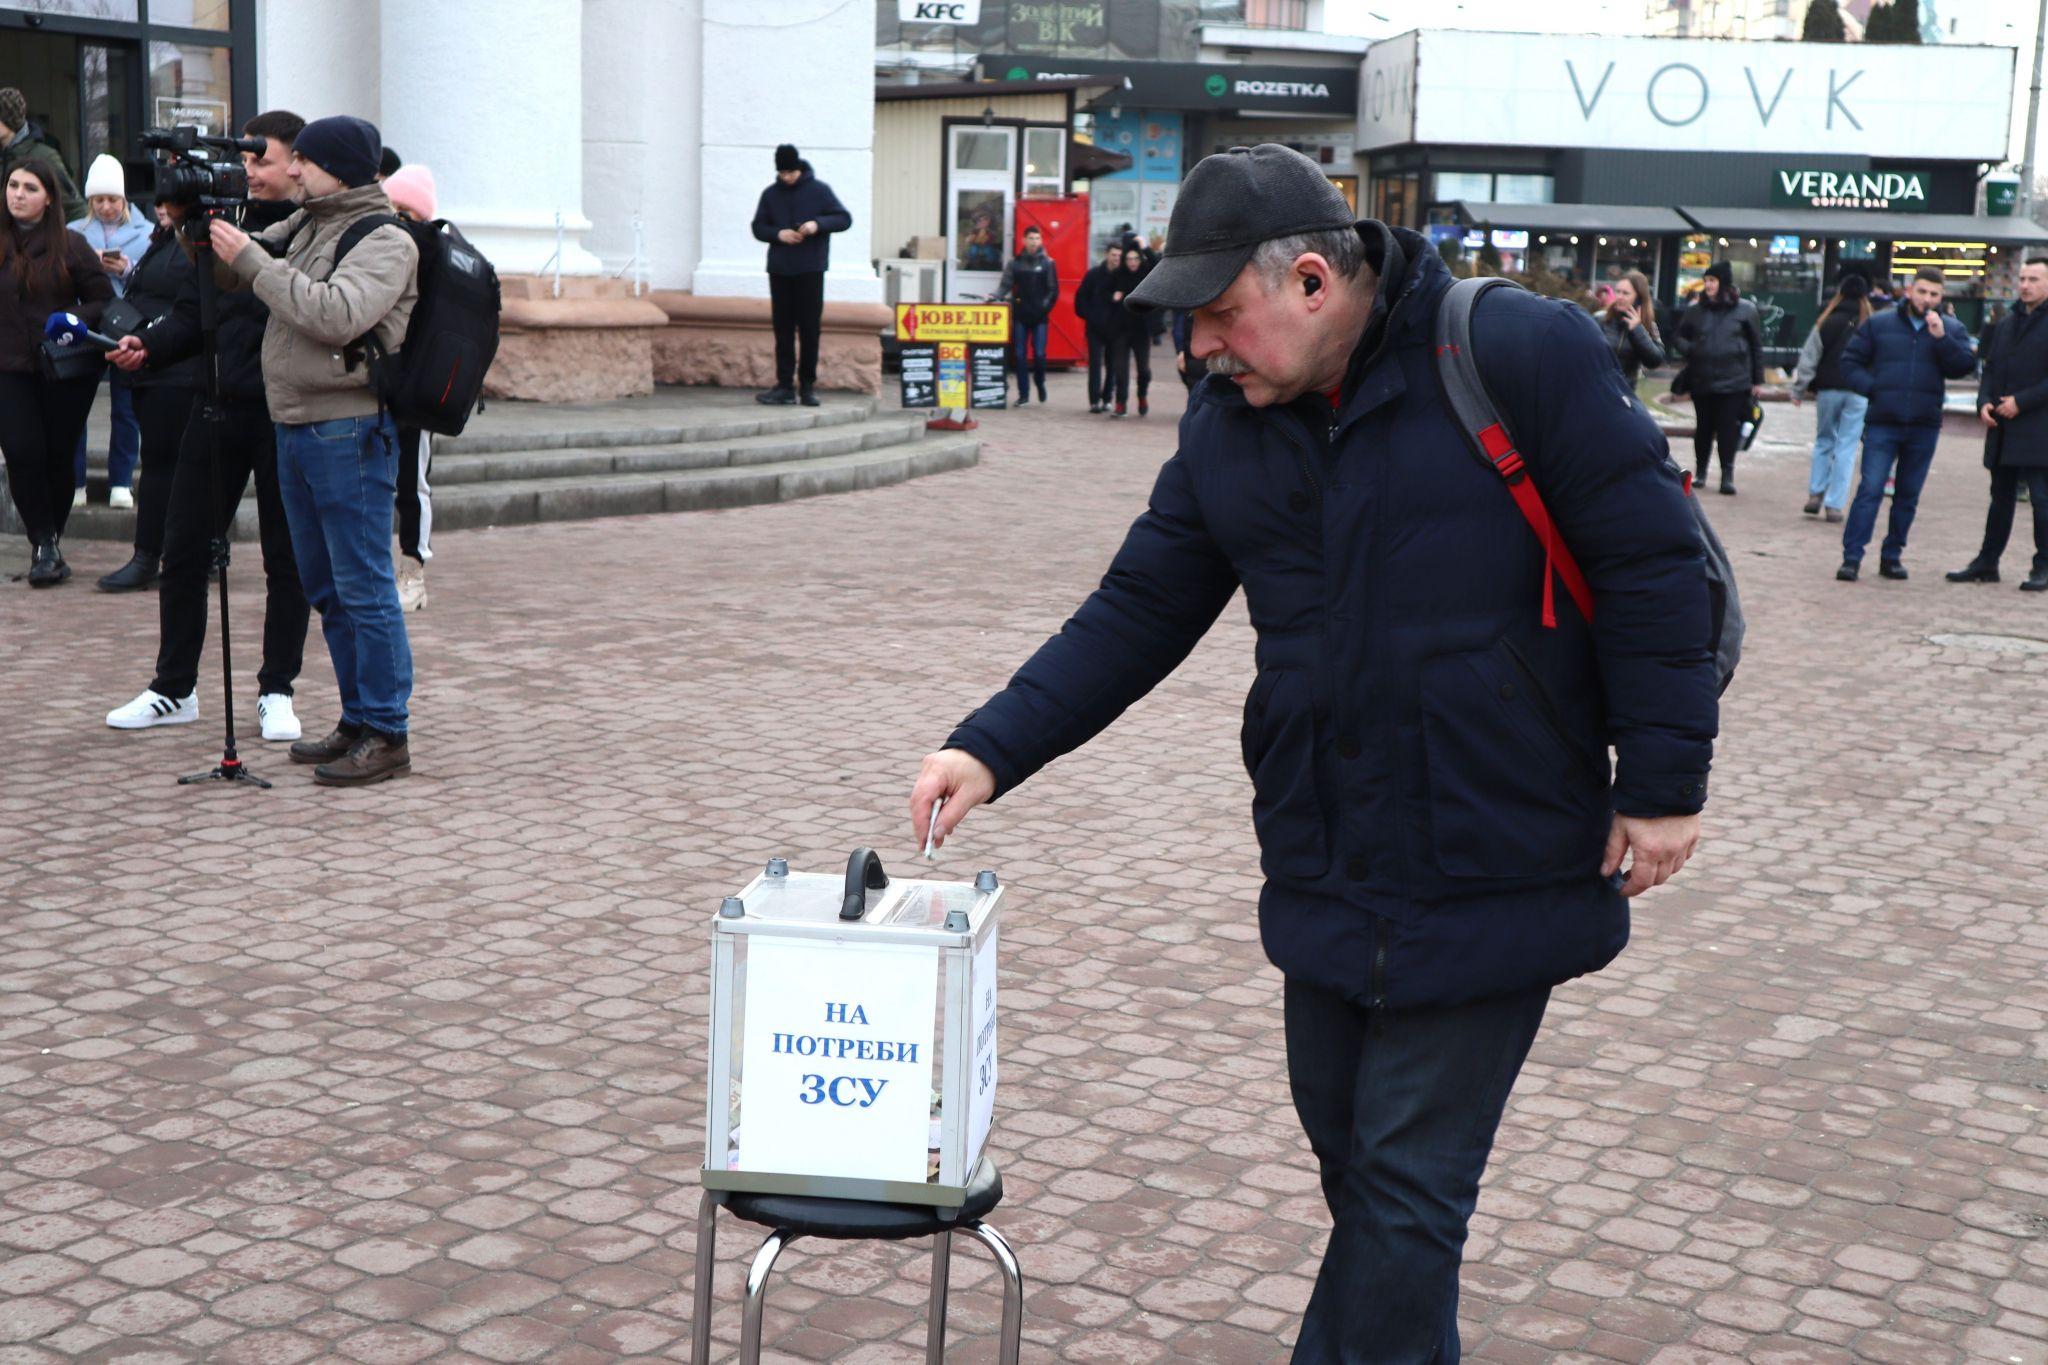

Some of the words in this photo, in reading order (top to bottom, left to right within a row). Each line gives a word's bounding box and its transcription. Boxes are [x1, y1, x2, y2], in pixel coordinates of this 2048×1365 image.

[915, 3, 965, 20] KFC
[1234, 80, 1330, 97] ROZETKA
[1564, 59, 1866, 131] VOVK
[1779, 170, 1925, 200] VERANDA
[1811, 196, 1860, 208] COFFEE
[1863, 198, 1889, 209] BAR
[920, 310, 1002, 326] ЮВЕЛІР
[824, 1002, 870, 1025] НА
[772, 1033, 920, 1064] ПОТРЕБИ
[799, 1073, 890, 1109] ЗСУ
